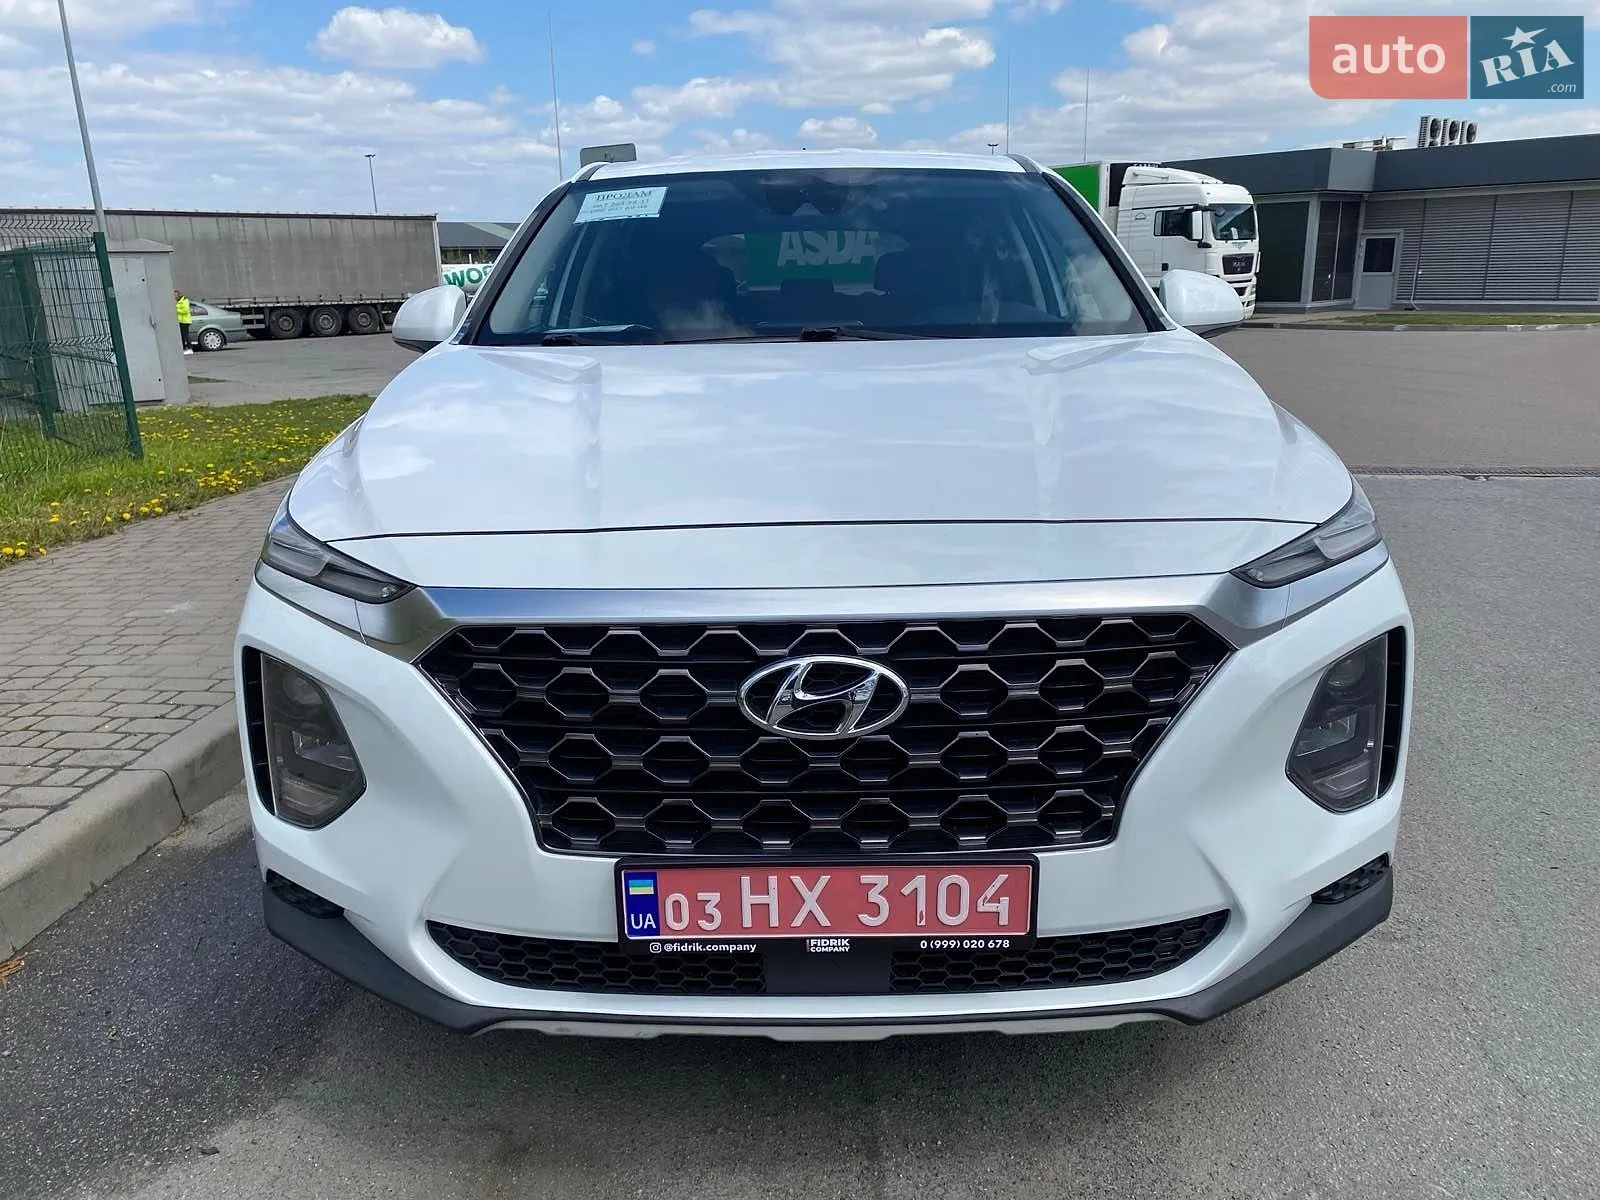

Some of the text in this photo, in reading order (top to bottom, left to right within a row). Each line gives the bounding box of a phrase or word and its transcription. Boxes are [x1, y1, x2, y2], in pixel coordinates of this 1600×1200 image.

[665, 874, 1009, 931] 03 HX 3104
[630, 913, 657, 930] UA
[663, 942, 757, 954] @fidrik.company
[810, 938, 851, 947] FIDRIK
[920, 939, 1010, 949] 0 (999) 020 678
